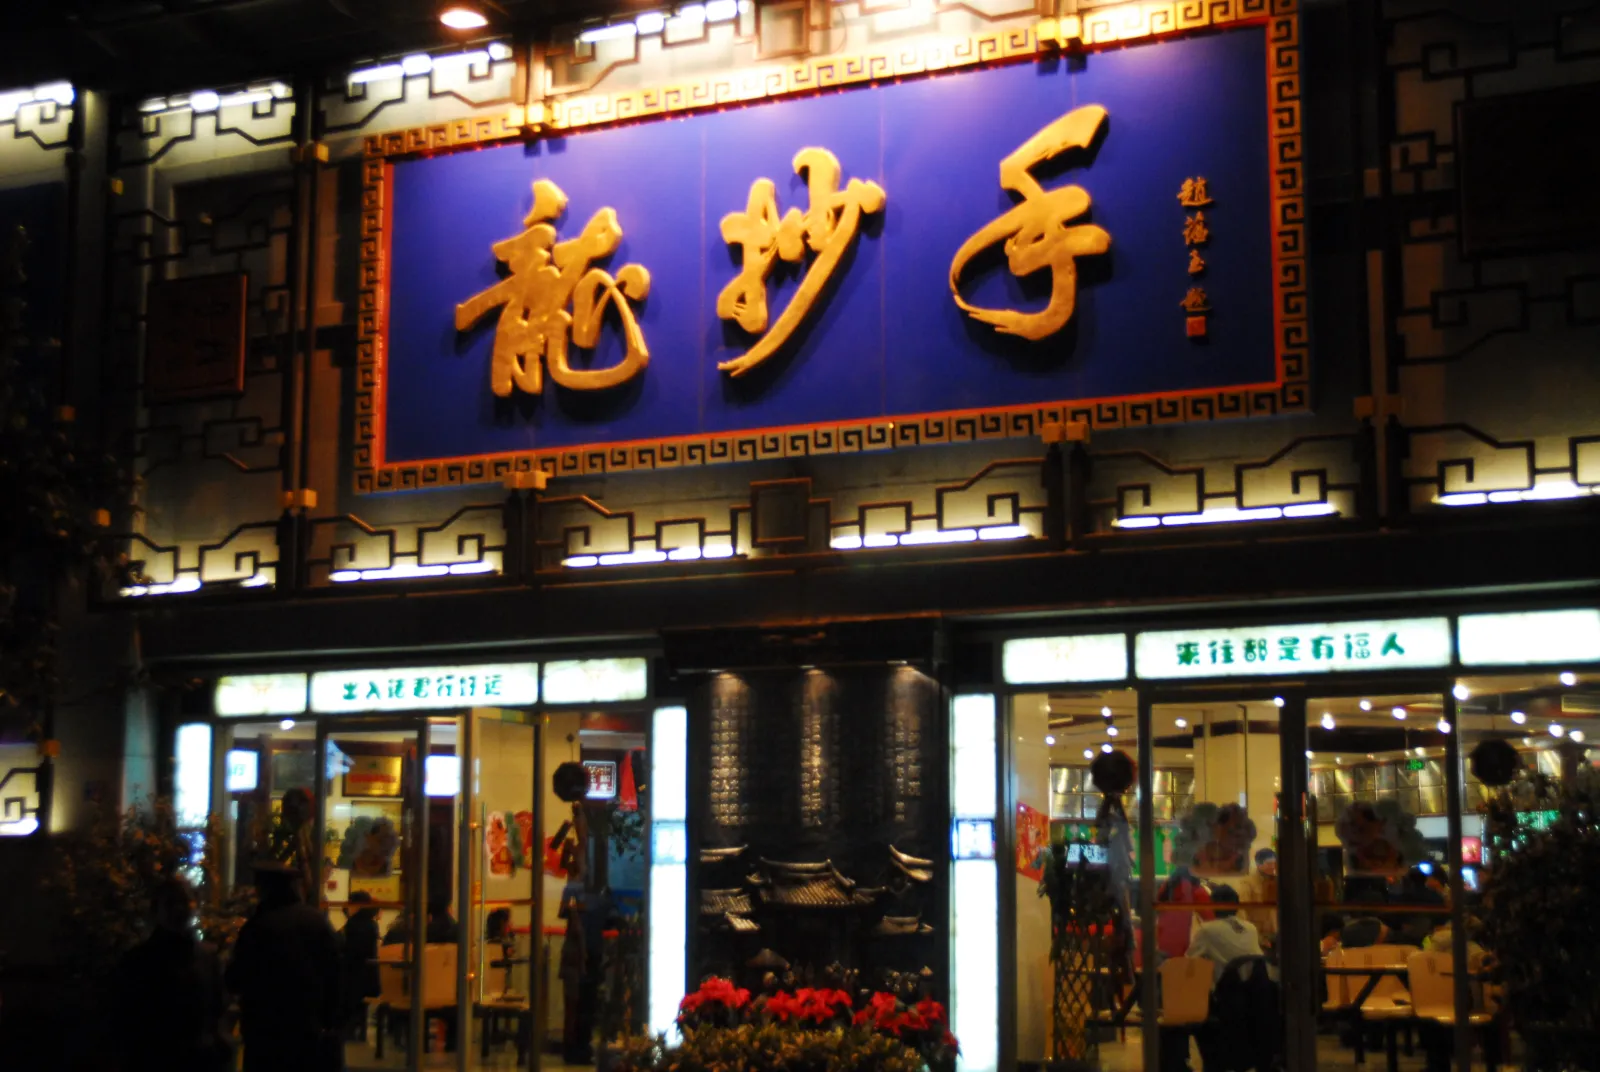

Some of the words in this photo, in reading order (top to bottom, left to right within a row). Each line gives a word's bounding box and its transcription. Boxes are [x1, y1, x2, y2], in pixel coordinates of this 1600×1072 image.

[1175, 632, 1406, 665] 来往都是有福人
